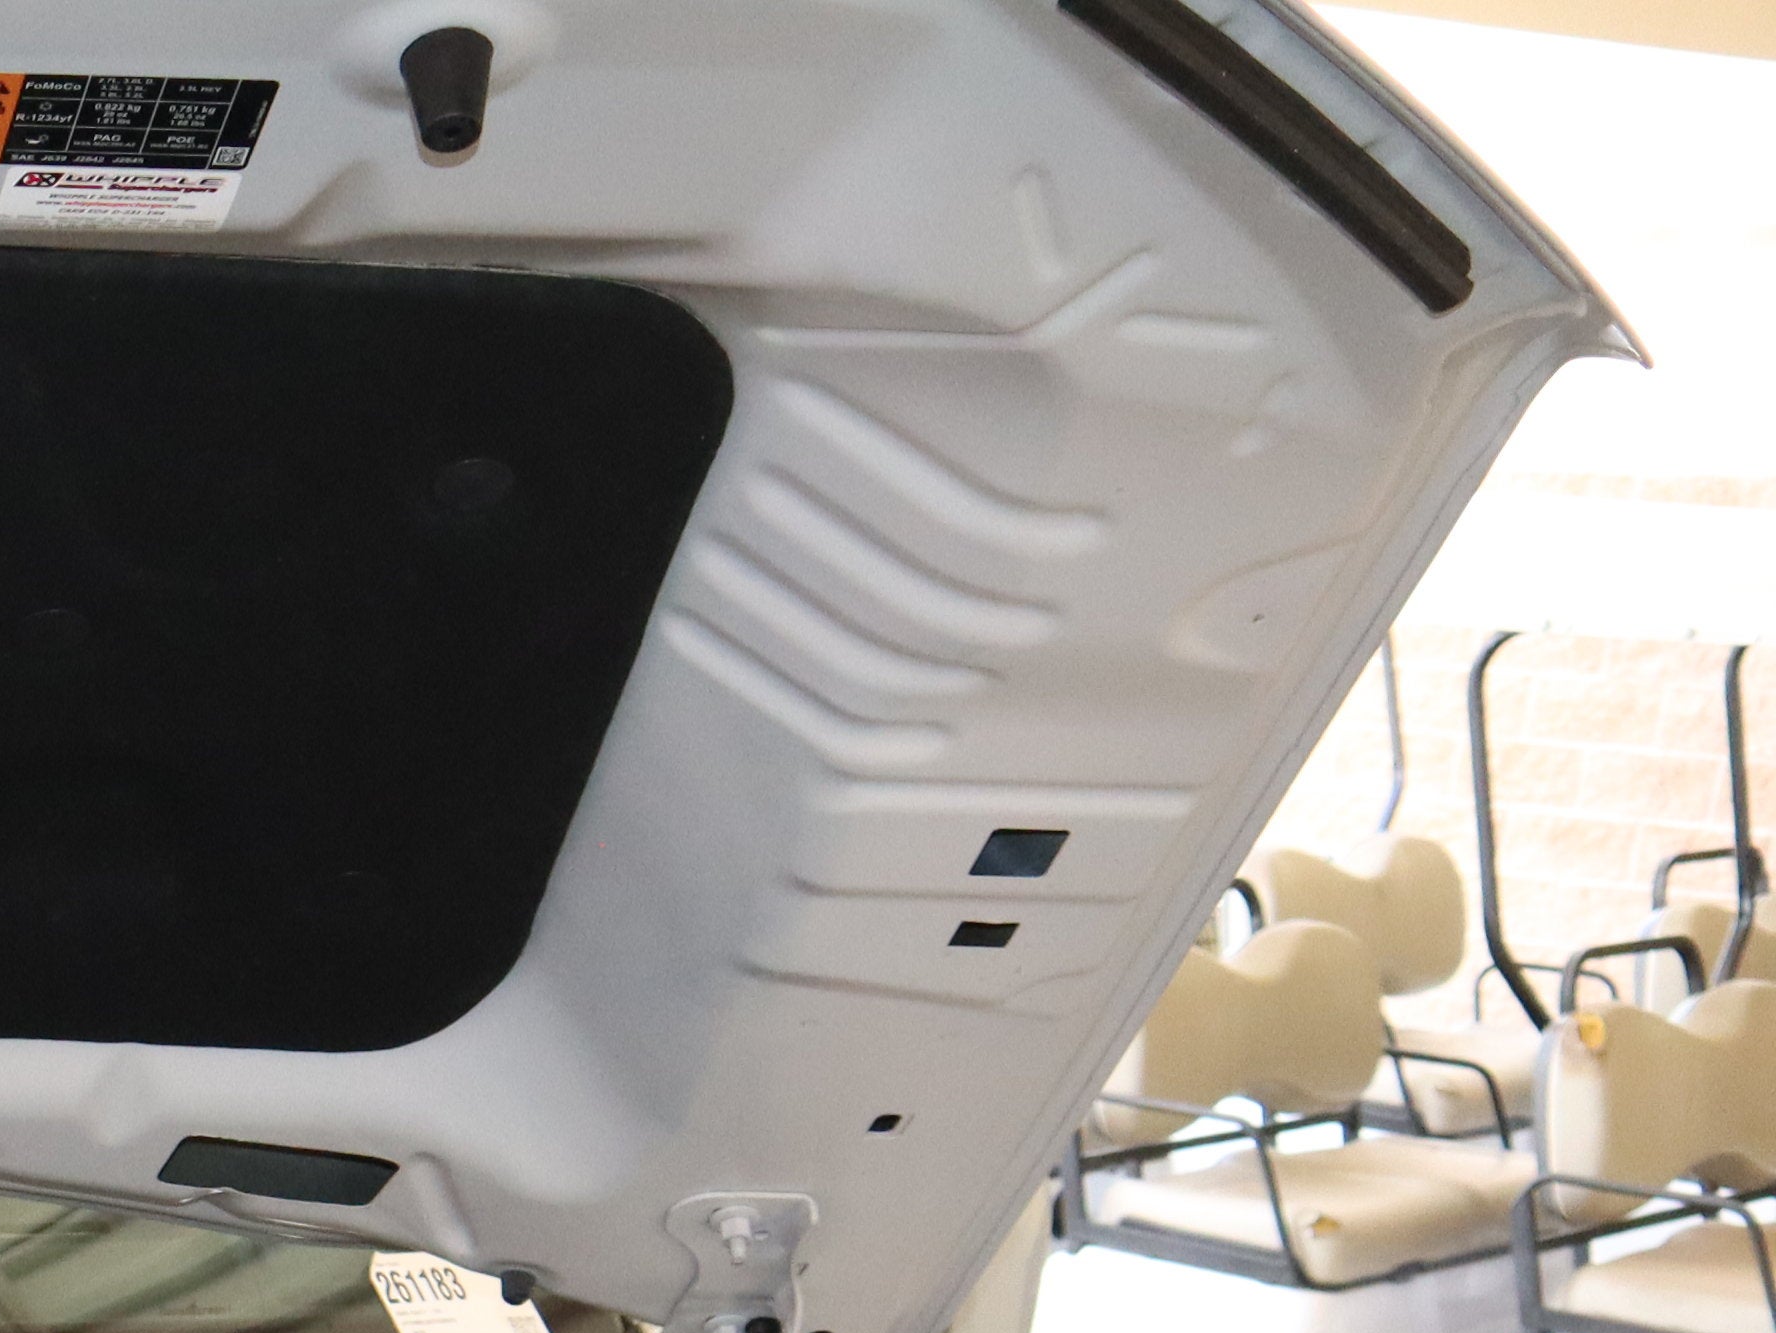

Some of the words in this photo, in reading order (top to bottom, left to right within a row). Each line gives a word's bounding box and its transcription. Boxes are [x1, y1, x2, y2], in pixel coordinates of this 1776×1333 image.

[25, 81, 82, 91] FoMoCo
[127, 103, 142, 113] kg
[201, 105, 217, 116] kg
[15, 112, 74, 123] R-1234yf
[93, 133, 122, 142] PAG
[167, 135, 196, 144] POE
[64, 174, 225, 185] WHIPPLE
[107, 182, 218, 193] Superchargers
[376, 1267, 467, 1304] 261183
